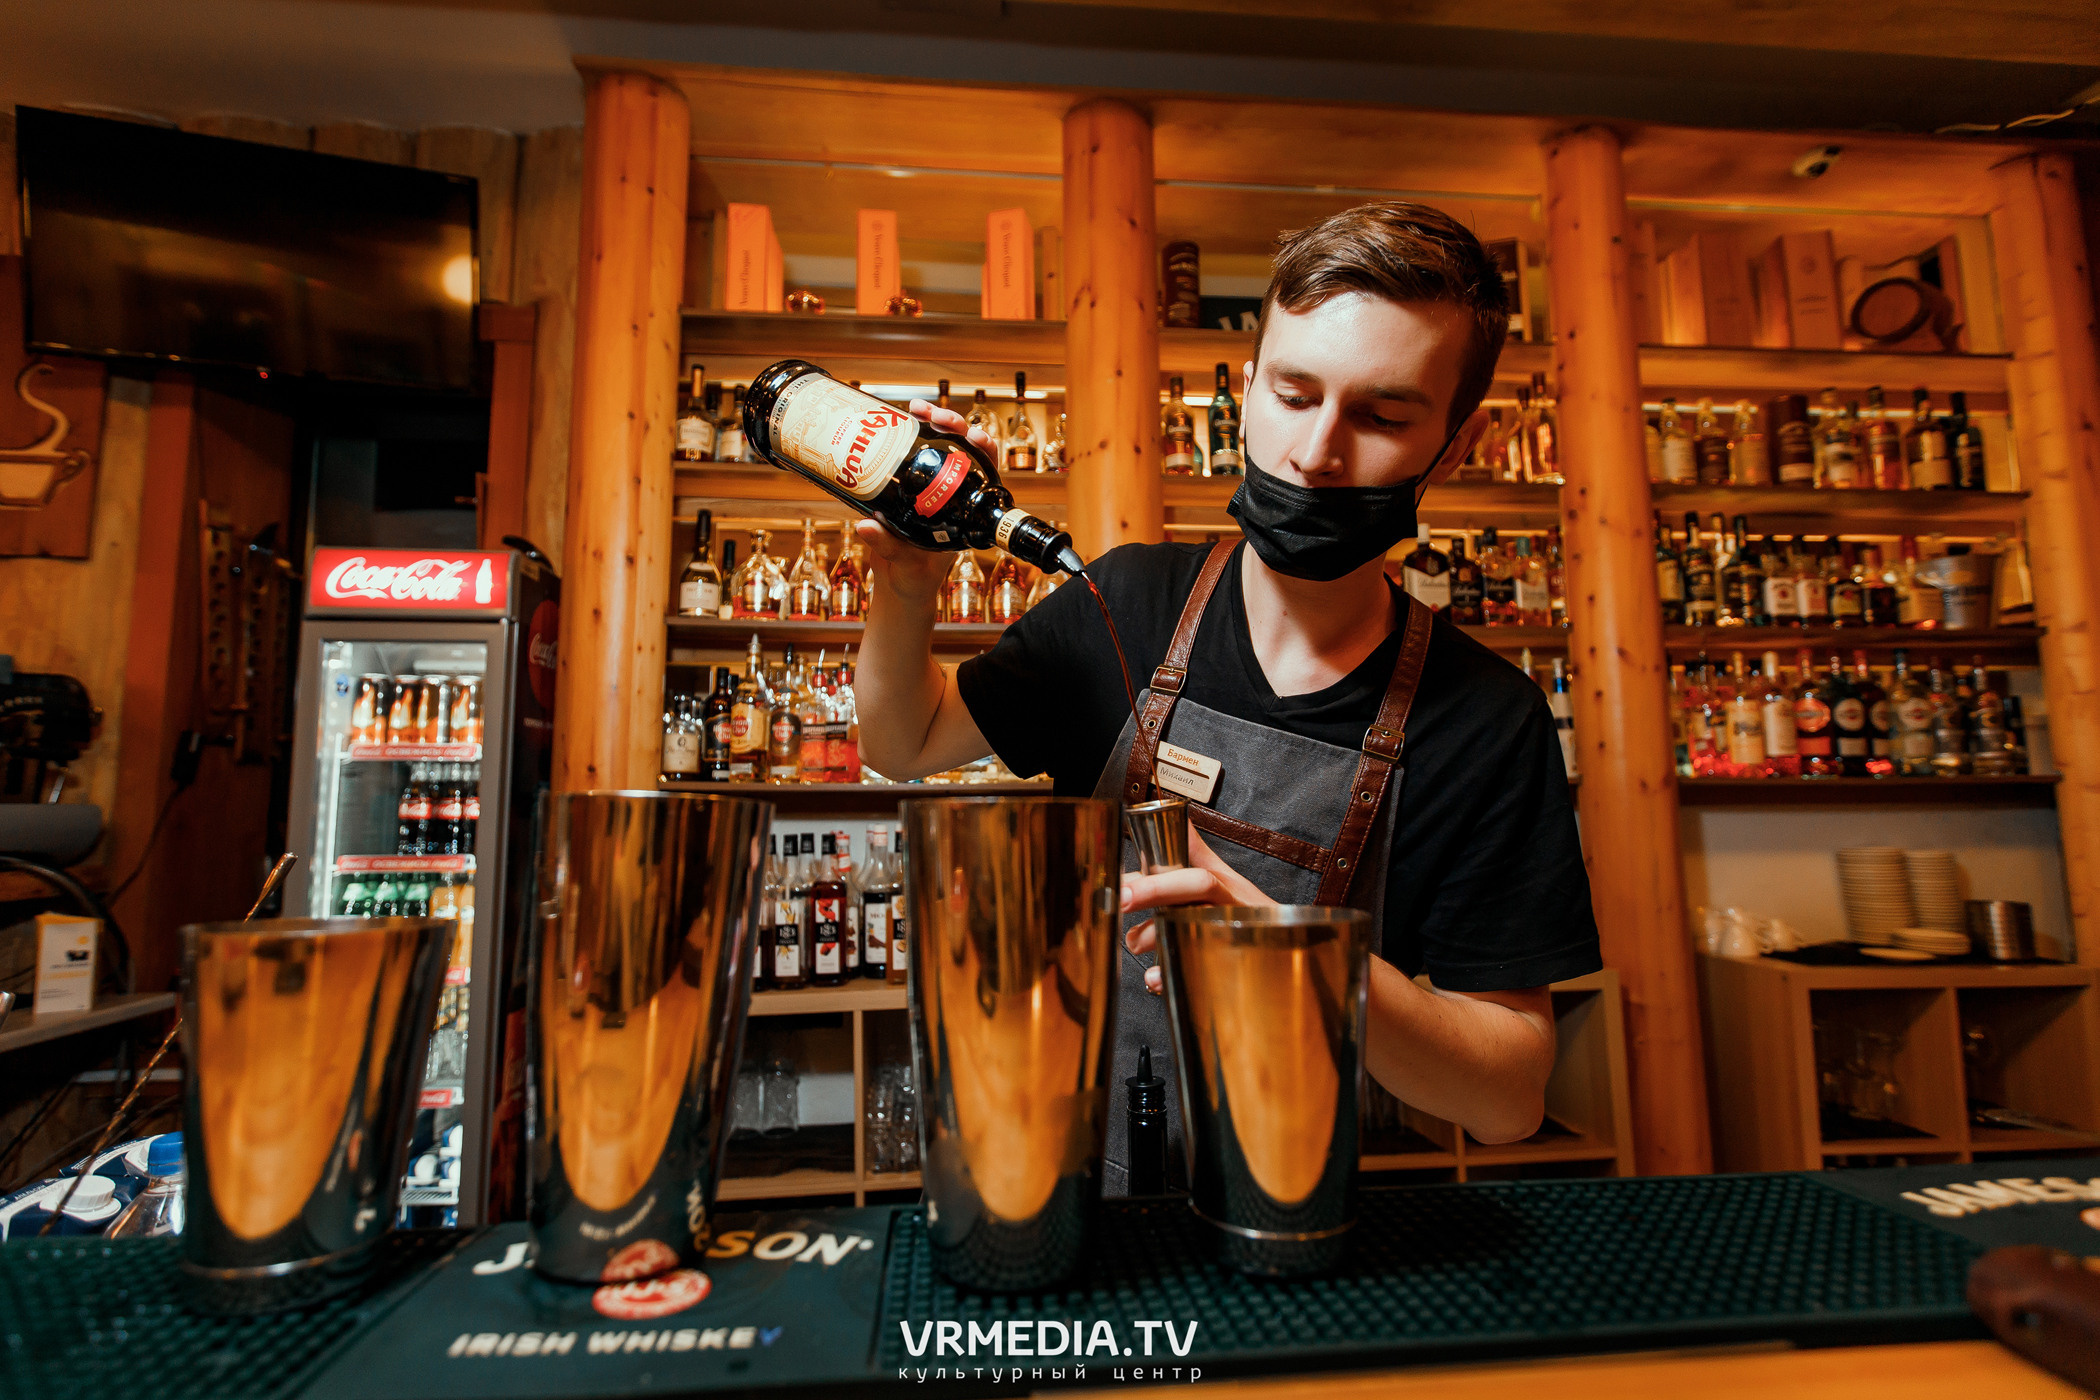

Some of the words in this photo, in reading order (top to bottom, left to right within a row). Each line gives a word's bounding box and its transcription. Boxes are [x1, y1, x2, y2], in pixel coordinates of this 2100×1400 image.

[773, 391, 793, 436] ORIGINAL
[835, 405, 909, 489] KAHLÚA
[924, 458, 963, 508] IMPORTED
[998, 517, 1015, 539] 1936
[1167, 748, 1200, 767] Бармен
[1160, 766, 1195, 786] Михаил
[447, 1330, 577, 1358] IRISH
[586, 1325, 783, 1356] WHISKEY
